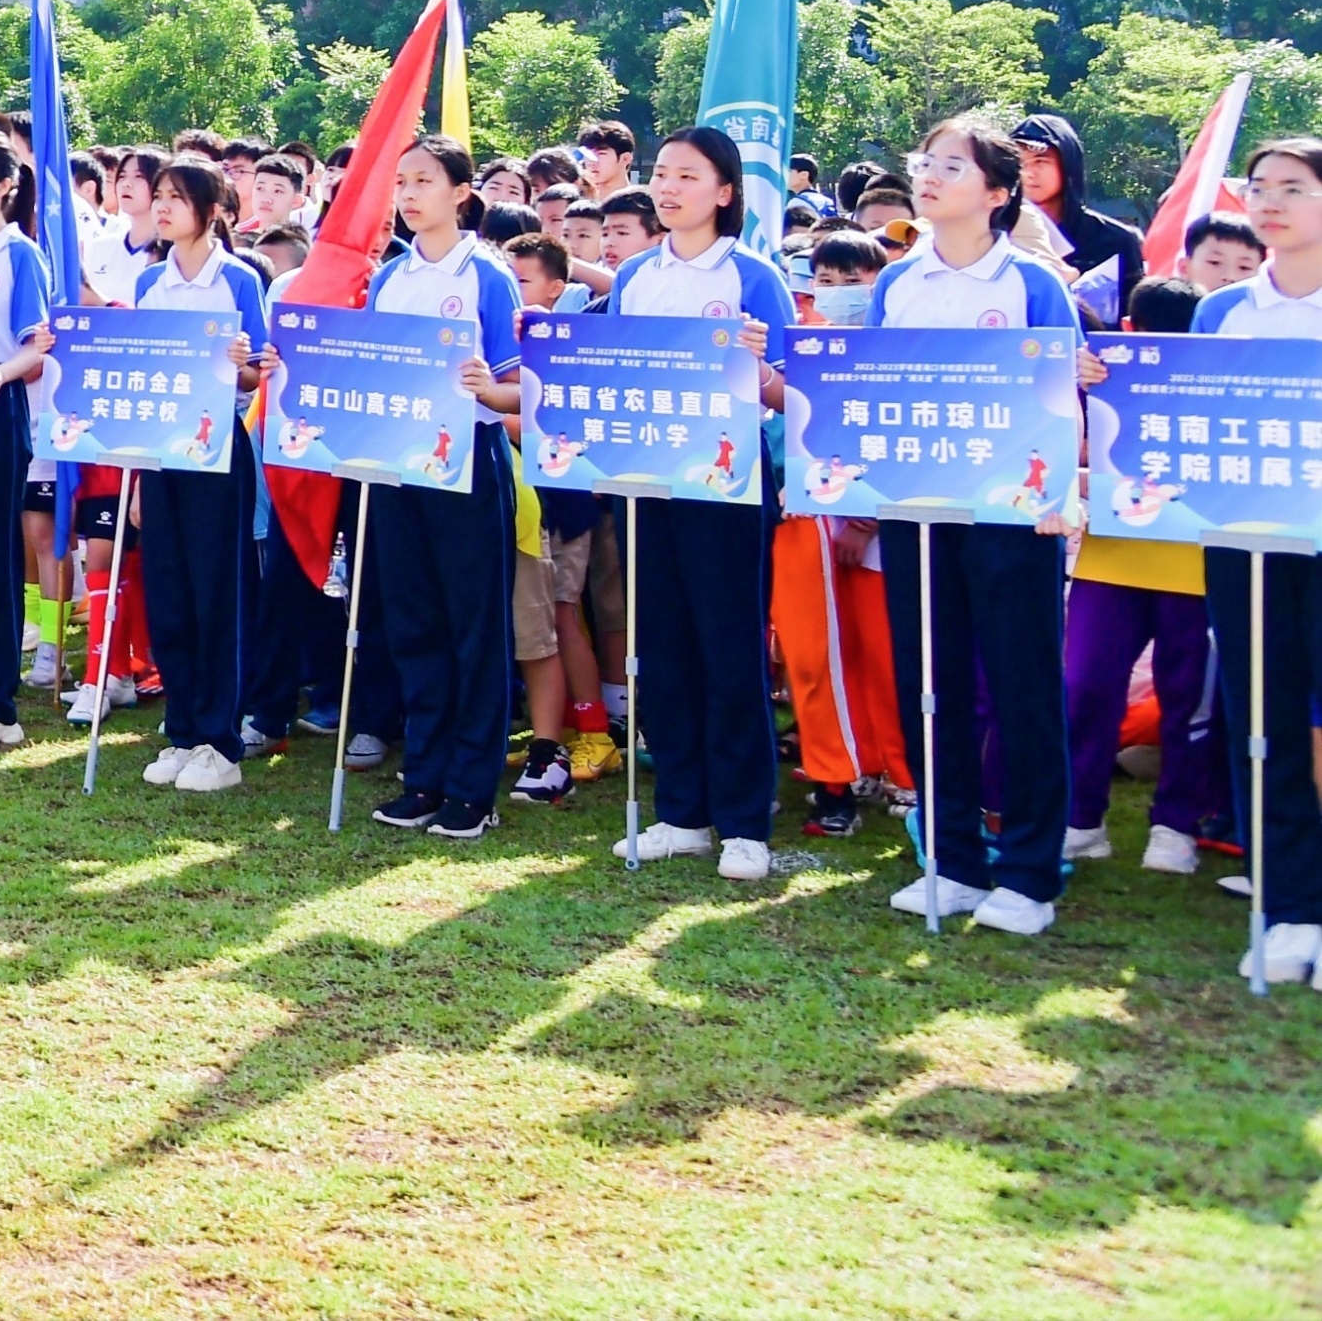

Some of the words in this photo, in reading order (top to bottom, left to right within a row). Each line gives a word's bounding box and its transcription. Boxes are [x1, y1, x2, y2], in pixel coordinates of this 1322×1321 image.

[82, 367, 192, 395] 海口市金盘
[91, 396, 179, 423] 实验学校
[298, 383, 433, 421] 海口山高学校
[542, 383, 732, 418] 海南省农垦直属
[842, 399, 1011, 429] 海口市琼山
[583, 418, 689, 448] 第三小学
[859, 434, 994, 465] 攀丹小学
[1140, 450, 1322, 489] 学院附属学
